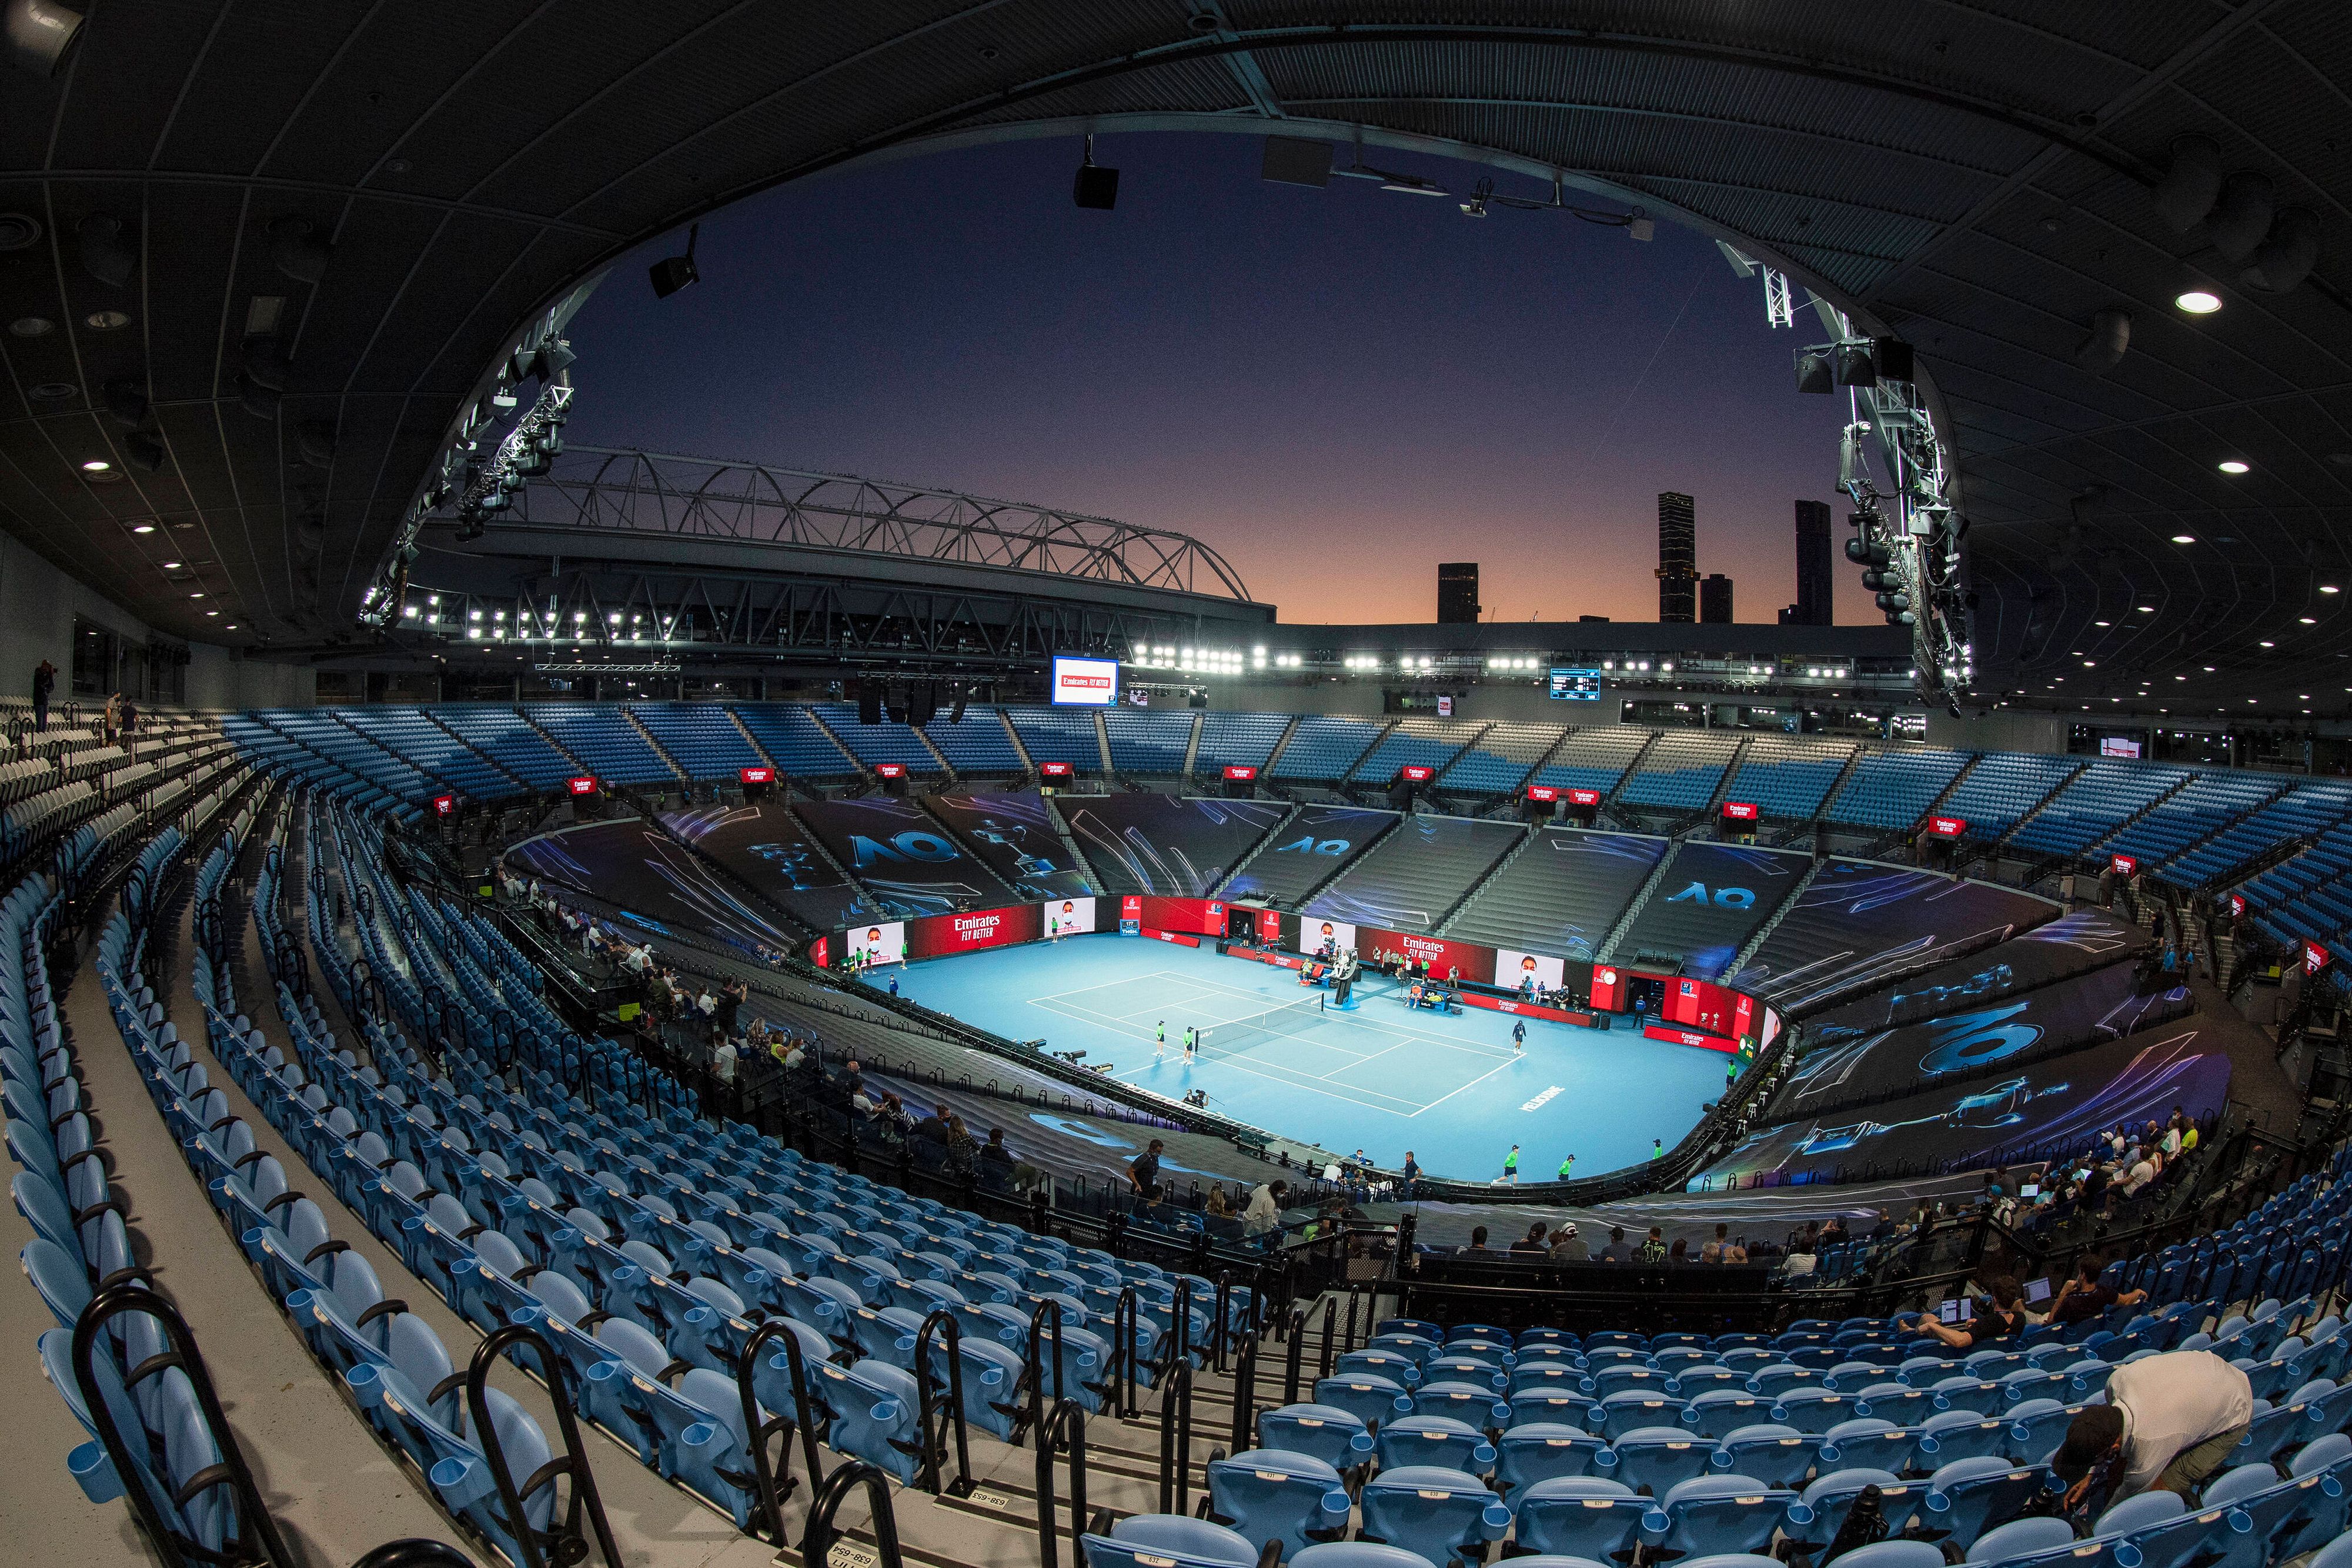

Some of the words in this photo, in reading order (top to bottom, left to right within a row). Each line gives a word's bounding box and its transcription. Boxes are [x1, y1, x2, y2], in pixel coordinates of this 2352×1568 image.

[1063, 677, 1088, 686] Emirates
[954, 915, 1000, 931] Emirates
[961, 930, 972, 941] FLY
[973, 927, 993, 940] BETTER
[1403, 936, 1444, 953] Emirates
[1275, 955, 1291, 964] Emirates
[1409, 948, 1417, 957] FLY
[1418, 950, 1438, 961] BETTER
[1498, 999, 1518, 1008] Emirates
[1737, 1007, 1749, 1017] Emirates
[1681, 1032, 1703, 1042] Emirates
[1518, 1085, 1566, 1112] MELBOURNE
[972, 1492, 1005, 1506] 638-653
[832, 1546, 871, 1564] 638-654
